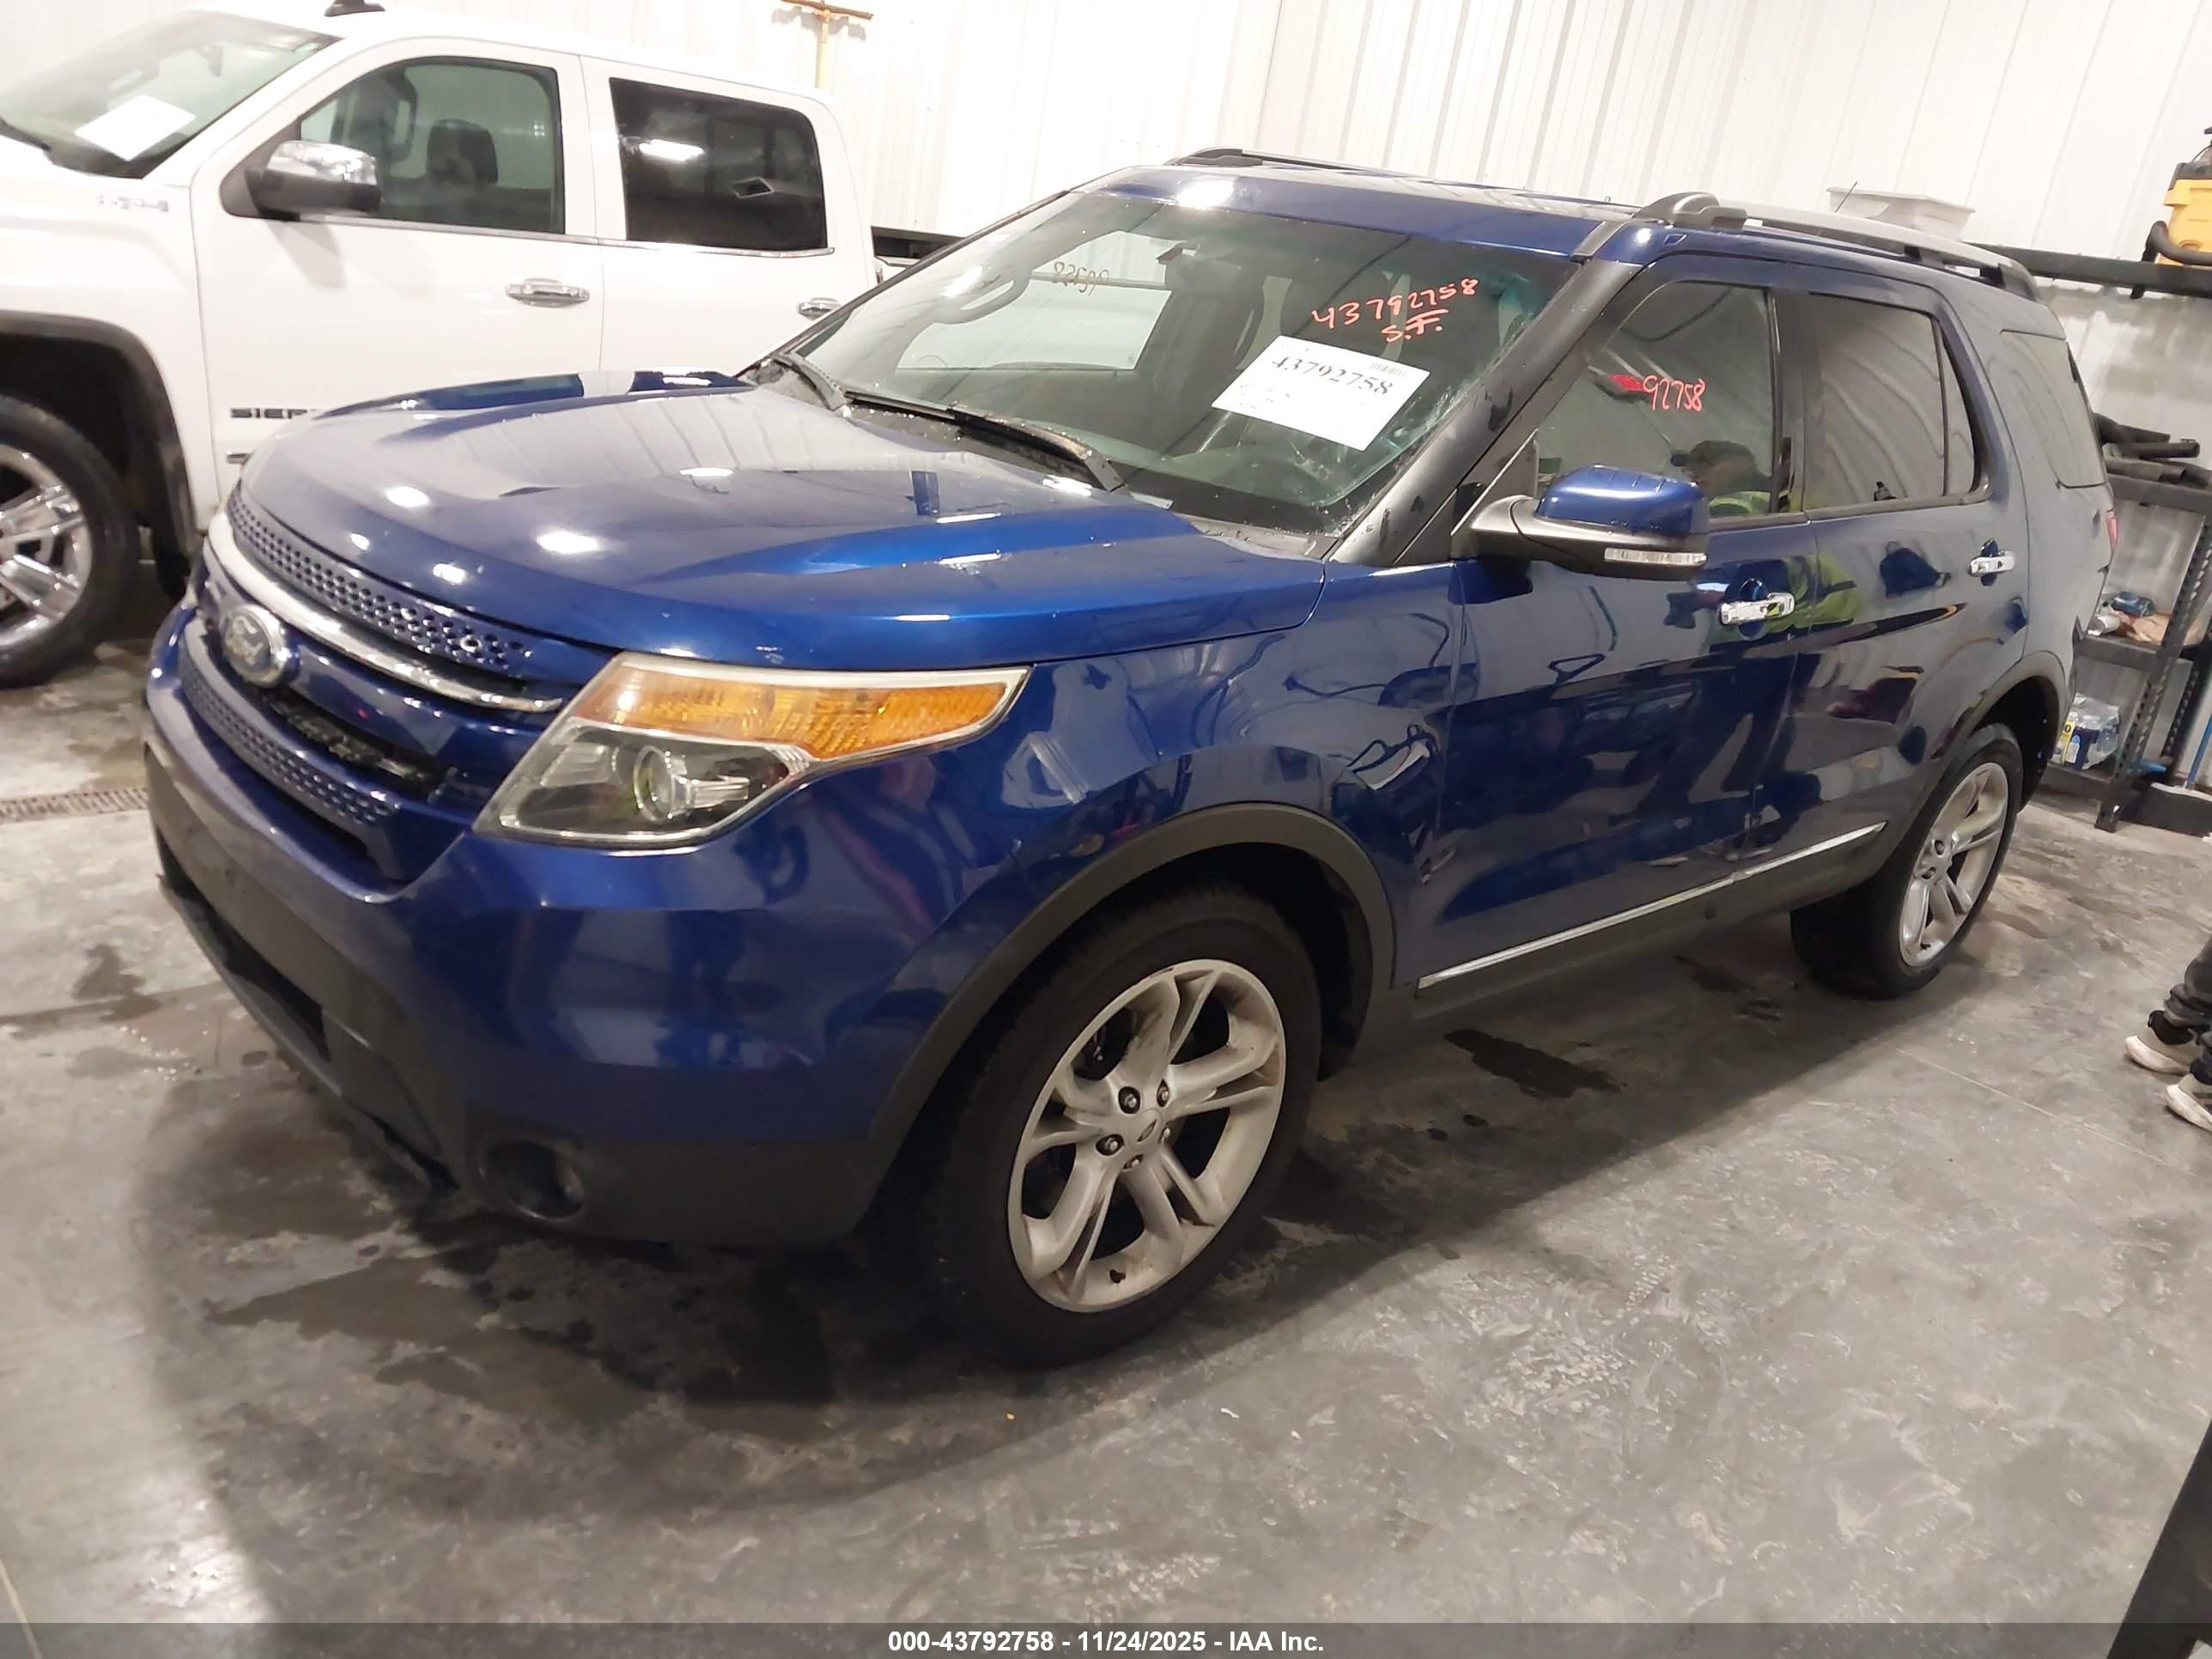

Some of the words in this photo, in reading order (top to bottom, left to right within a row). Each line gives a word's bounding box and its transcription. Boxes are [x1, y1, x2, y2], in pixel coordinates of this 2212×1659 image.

[1311, 277, 1479, 329] 43792758
[1271, 356, 1394, 395] 43792758
[1643, 374, 1706, 412] 92758
[230, 408, 317, 420] SIER
